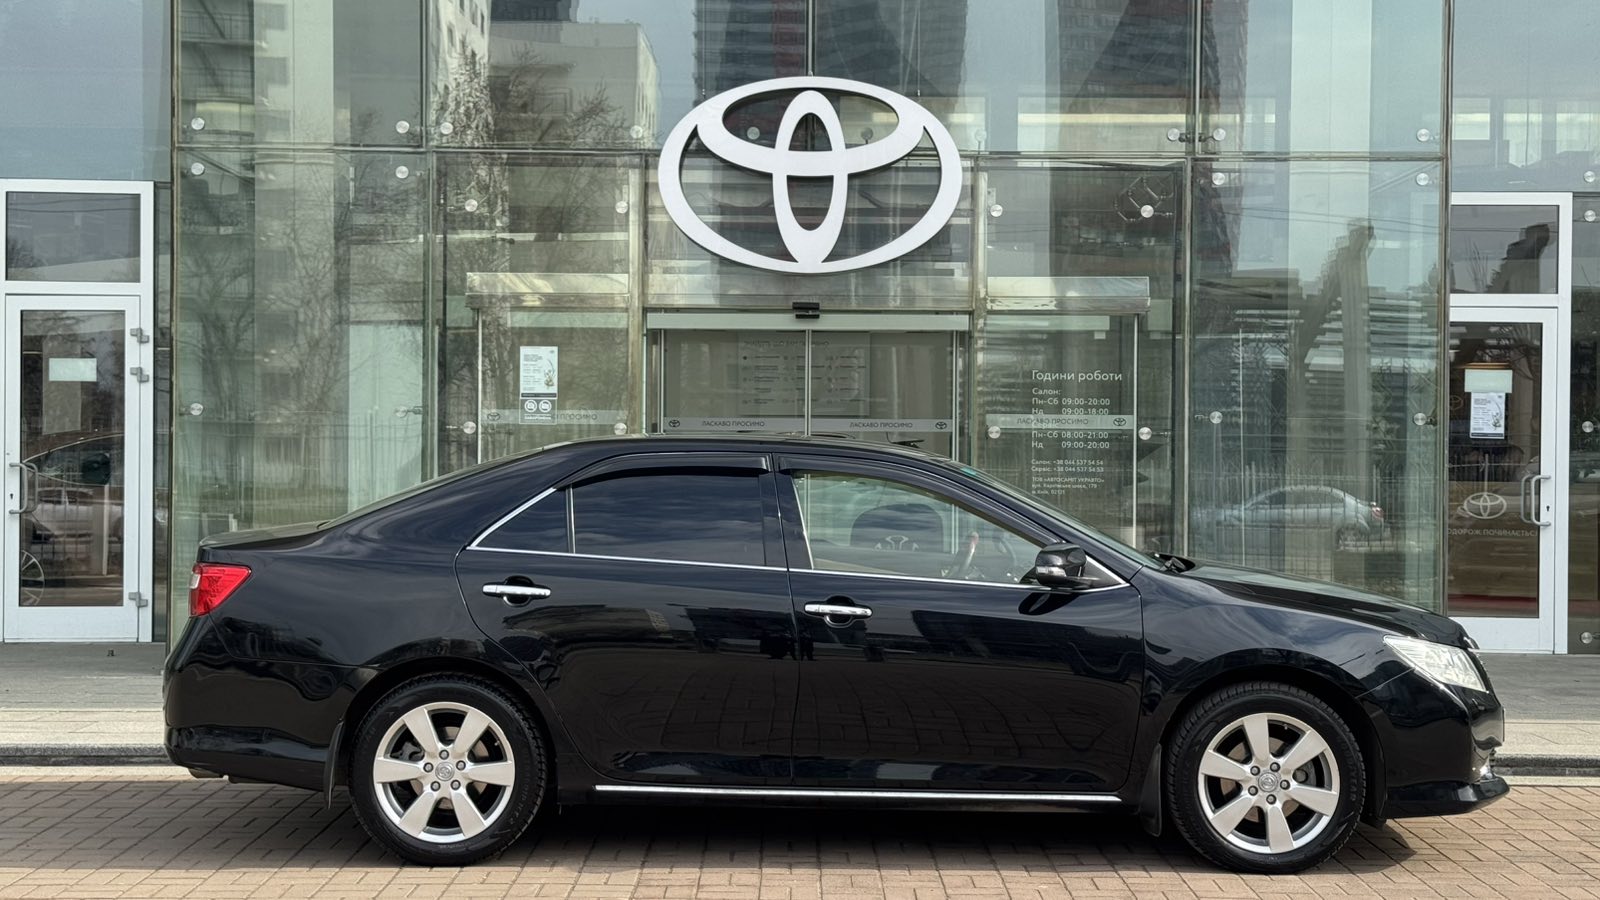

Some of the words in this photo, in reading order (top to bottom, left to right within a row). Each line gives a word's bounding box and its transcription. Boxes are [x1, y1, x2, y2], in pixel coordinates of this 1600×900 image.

[1032, 370, 1075, 381] Години
[1078, 370, 1122, 383] роботи
[1061, 398, 1110, 406] 09:00-20:00
[1061, 431, 1109, 439] 08:00-21:00
[1032, 441, 1044, 449] Нд
[1061, 441, 1110, 449] 09:00-20:00
